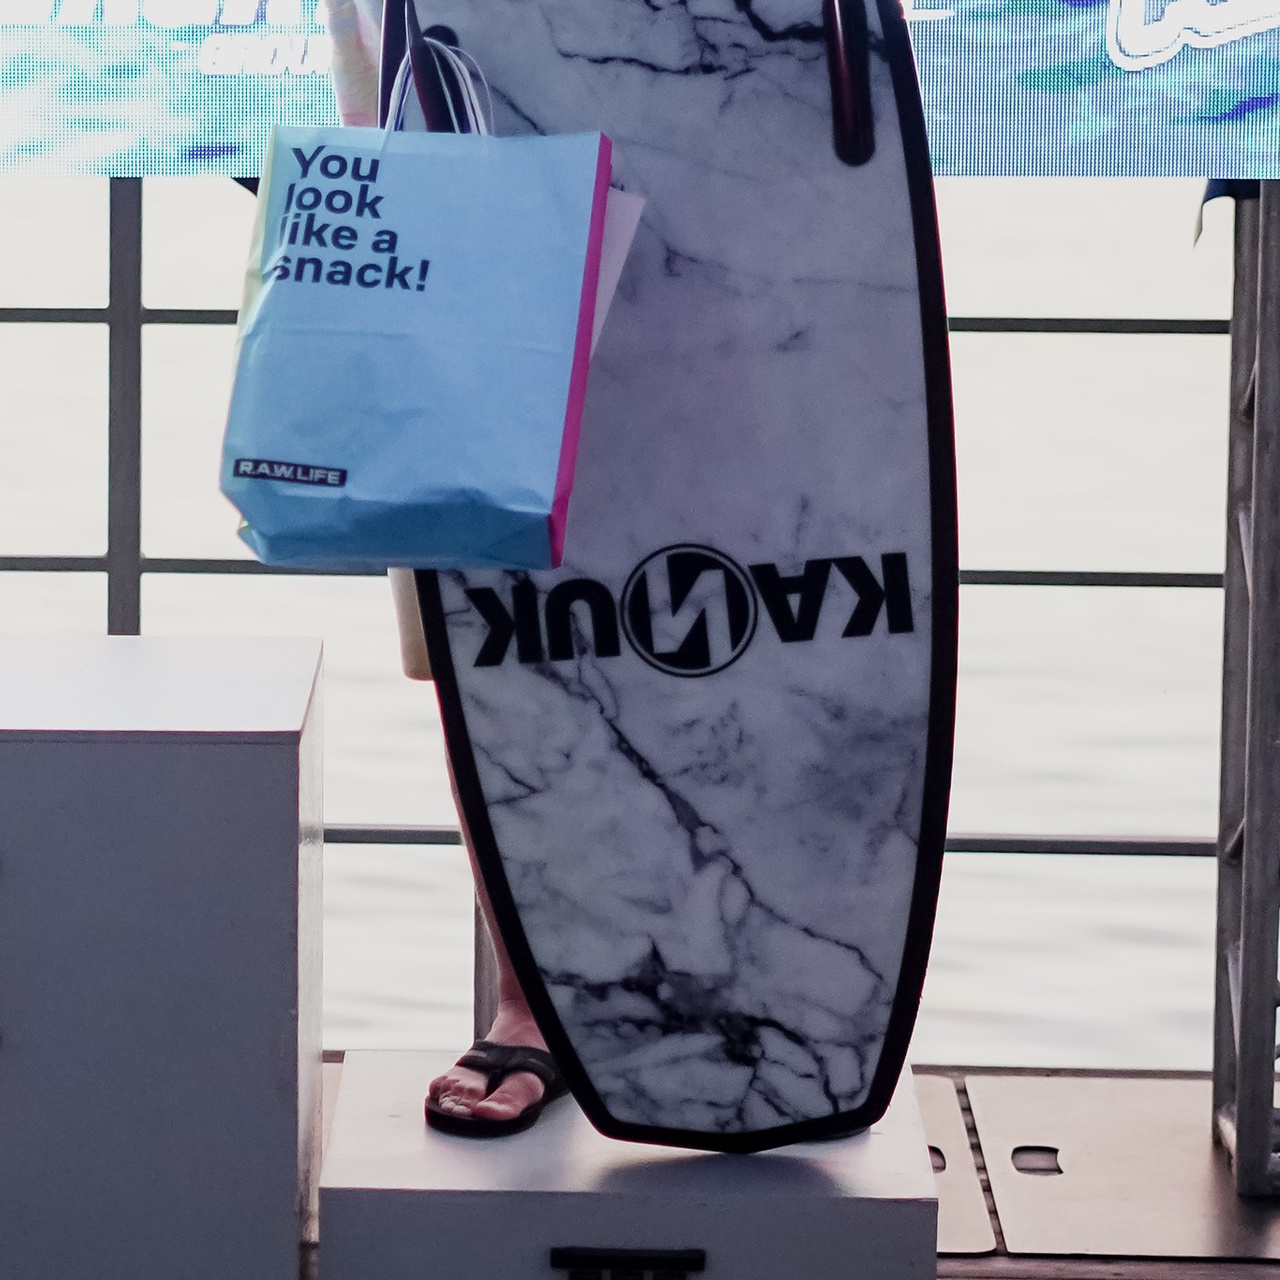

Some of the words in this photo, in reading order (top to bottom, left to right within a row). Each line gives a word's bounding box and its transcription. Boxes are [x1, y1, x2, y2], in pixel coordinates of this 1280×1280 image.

[292, 145, 380, 183] You
[283, 183, 385, 220] look
[279, 212, 359, 250] like
[371, 229, 398, 254] a
[269, 255, 430, 292] snack!
